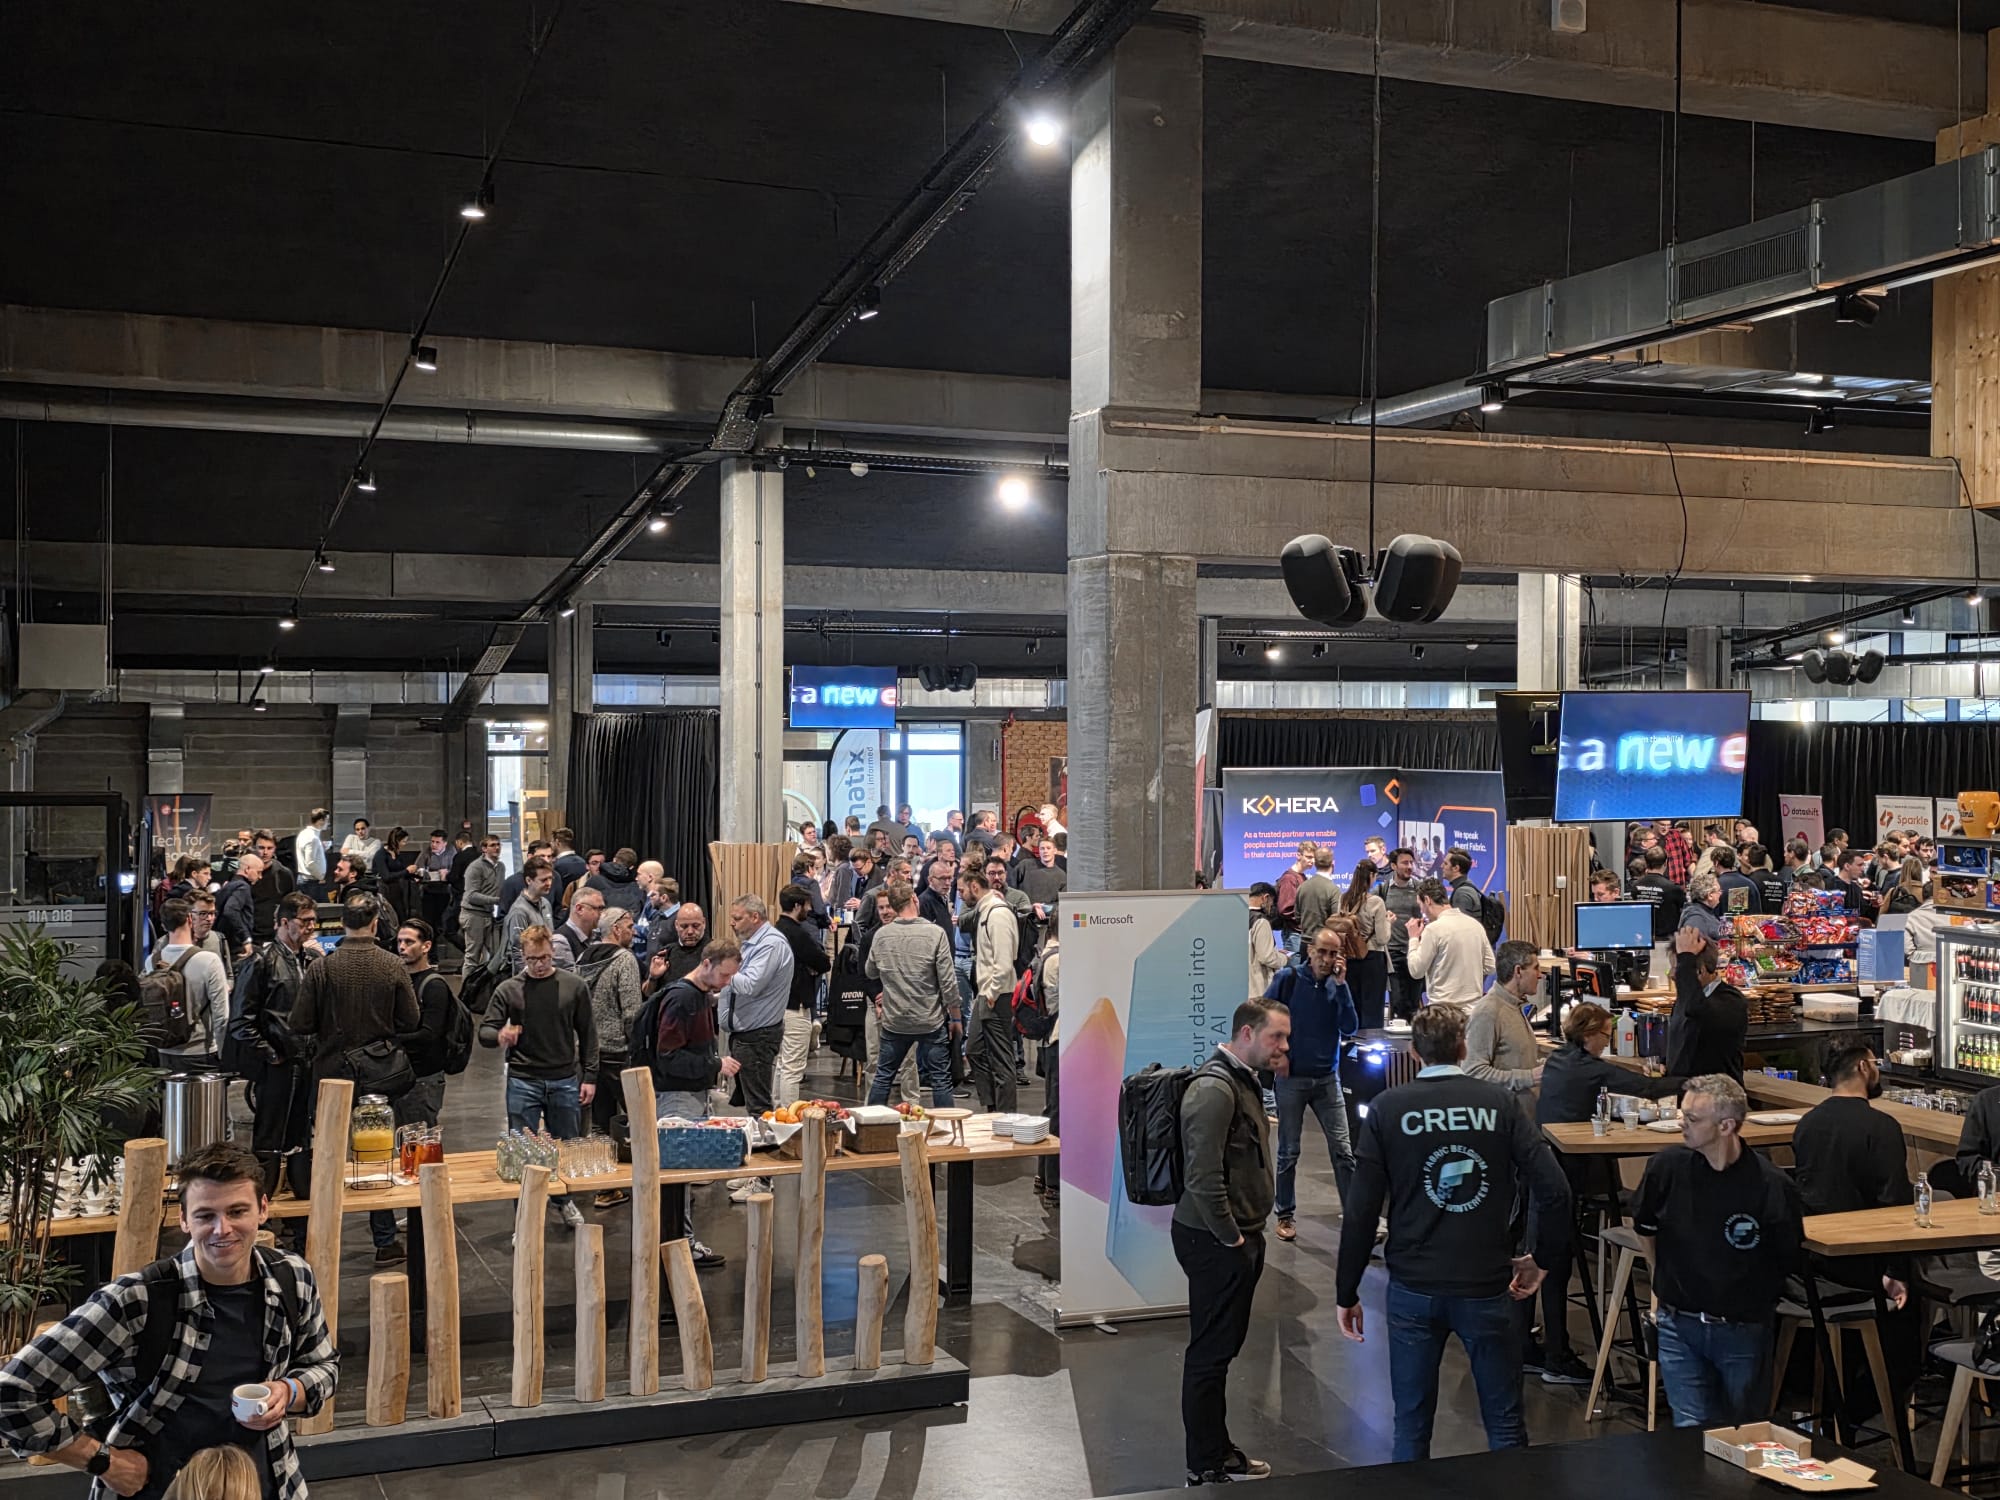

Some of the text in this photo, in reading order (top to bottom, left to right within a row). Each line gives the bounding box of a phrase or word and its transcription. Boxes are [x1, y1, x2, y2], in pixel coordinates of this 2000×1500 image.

[822, 686, 878, 705] new
[1618, 735, 1715, 771] new
[867, 746, 875, 785] informed
[1243, 795, 1339, 816] KOHERA
[1791, 807, 1819, 817] datashift
[1897, 815, 1929, 826] Sparkle
[152, 833, 205, 847] Tech for
[1244, 841, 1265, 849] people
[1321, 841, 1337, 849] grow
[1453, 831, 1479, 840] We speak
[1089, 914, 1134, 925] Microsoft
[1188, 938, 1206, 976] into
[1188, 983, 1206, 1026] data
[1211, 1015, 1227, 1035] AI
[1401, 1107, 1497, 1136] CREW
[1423, 1144, 1488, 1172] FABRIC BELGIUM
[1423, 1180, 1446, 1208] FABRIC
